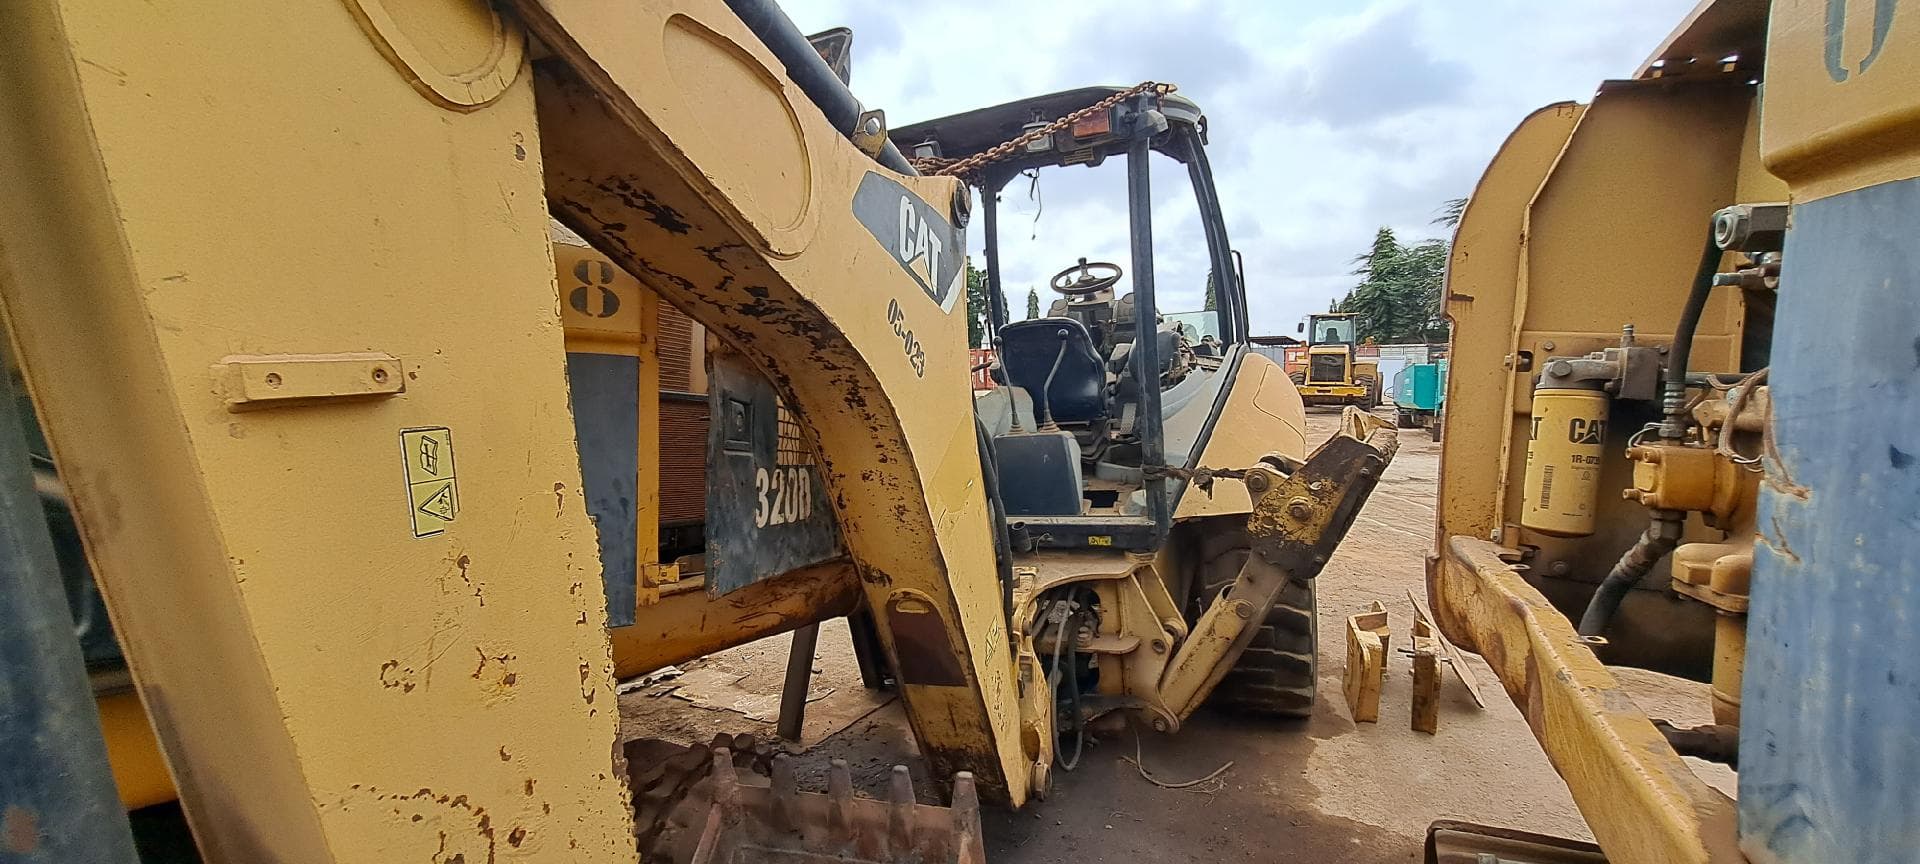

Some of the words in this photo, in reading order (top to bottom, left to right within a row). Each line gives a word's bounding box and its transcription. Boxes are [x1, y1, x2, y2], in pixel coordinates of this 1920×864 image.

[900, 195, 942, 296] CAT
[569, 260, 621, 318] 8
[887, 298, 925, 378] 05-023
[1568, 417, 1607, 445] CAT
[755, 467, 812, 528] 320D
